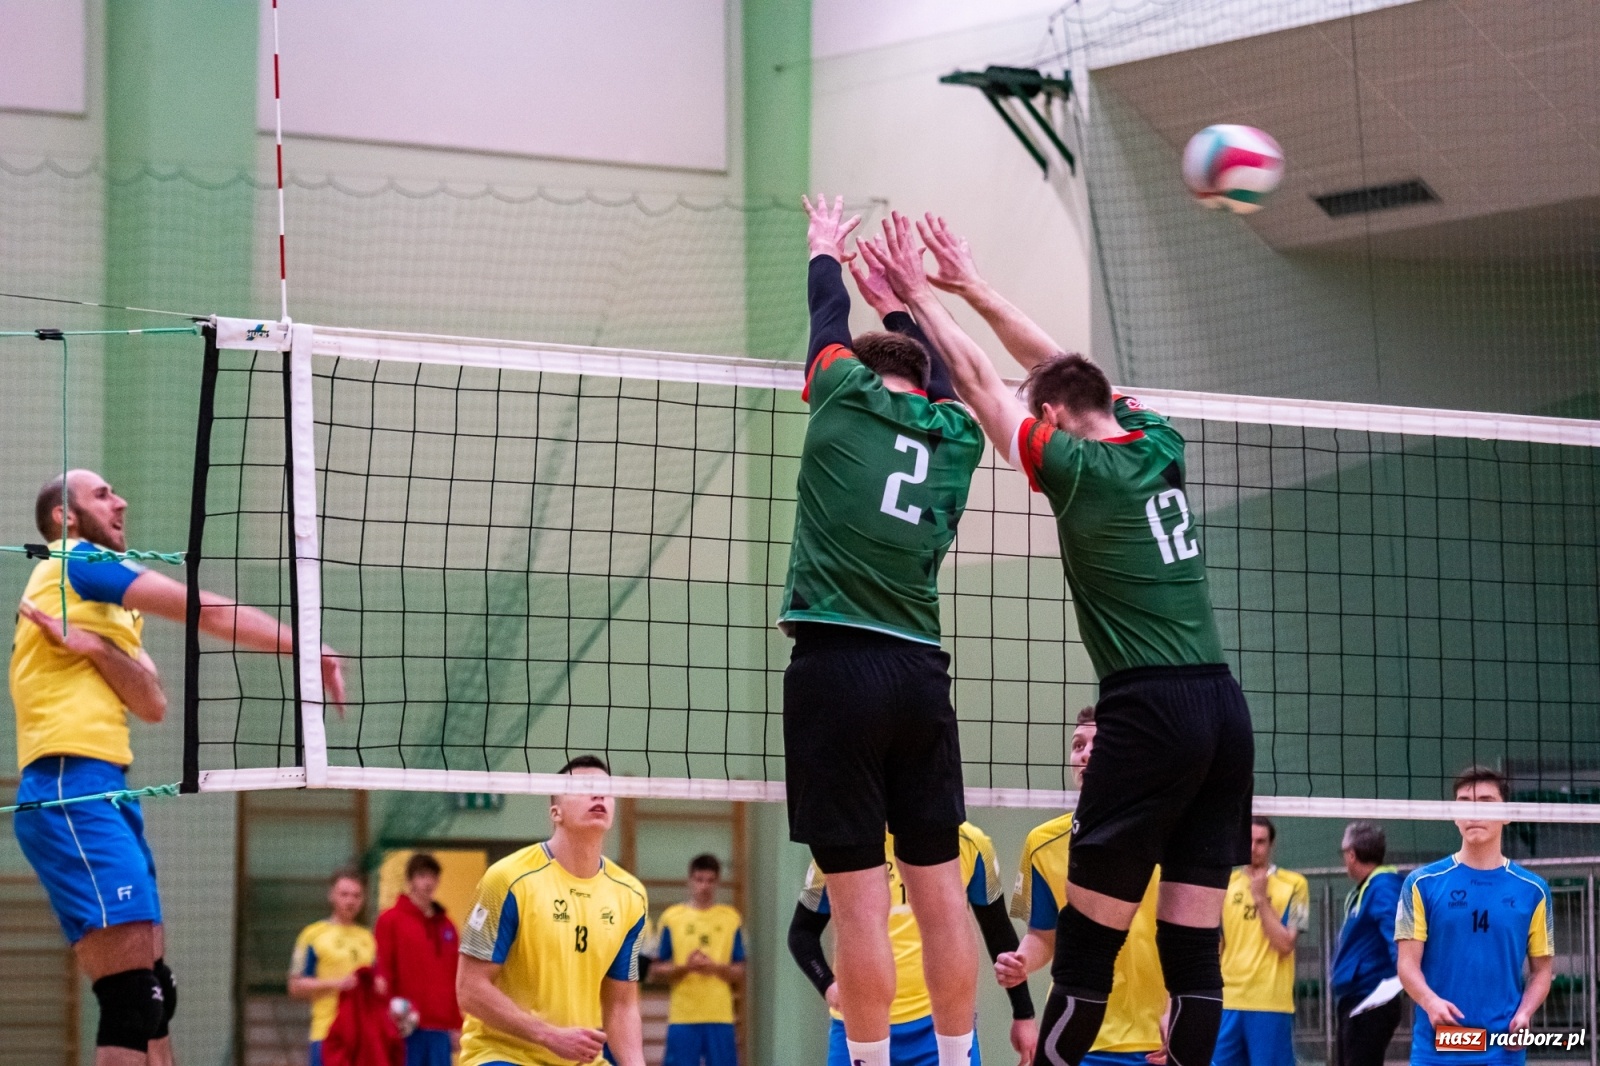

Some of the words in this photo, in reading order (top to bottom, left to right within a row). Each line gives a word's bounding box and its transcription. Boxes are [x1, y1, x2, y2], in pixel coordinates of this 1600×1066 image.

[880, 434, 929, 525] 2
[1145, 488, 1199, 564] 12
[575, 925, 588, 953] 13
[1472, 909, 1489, 933] 14
